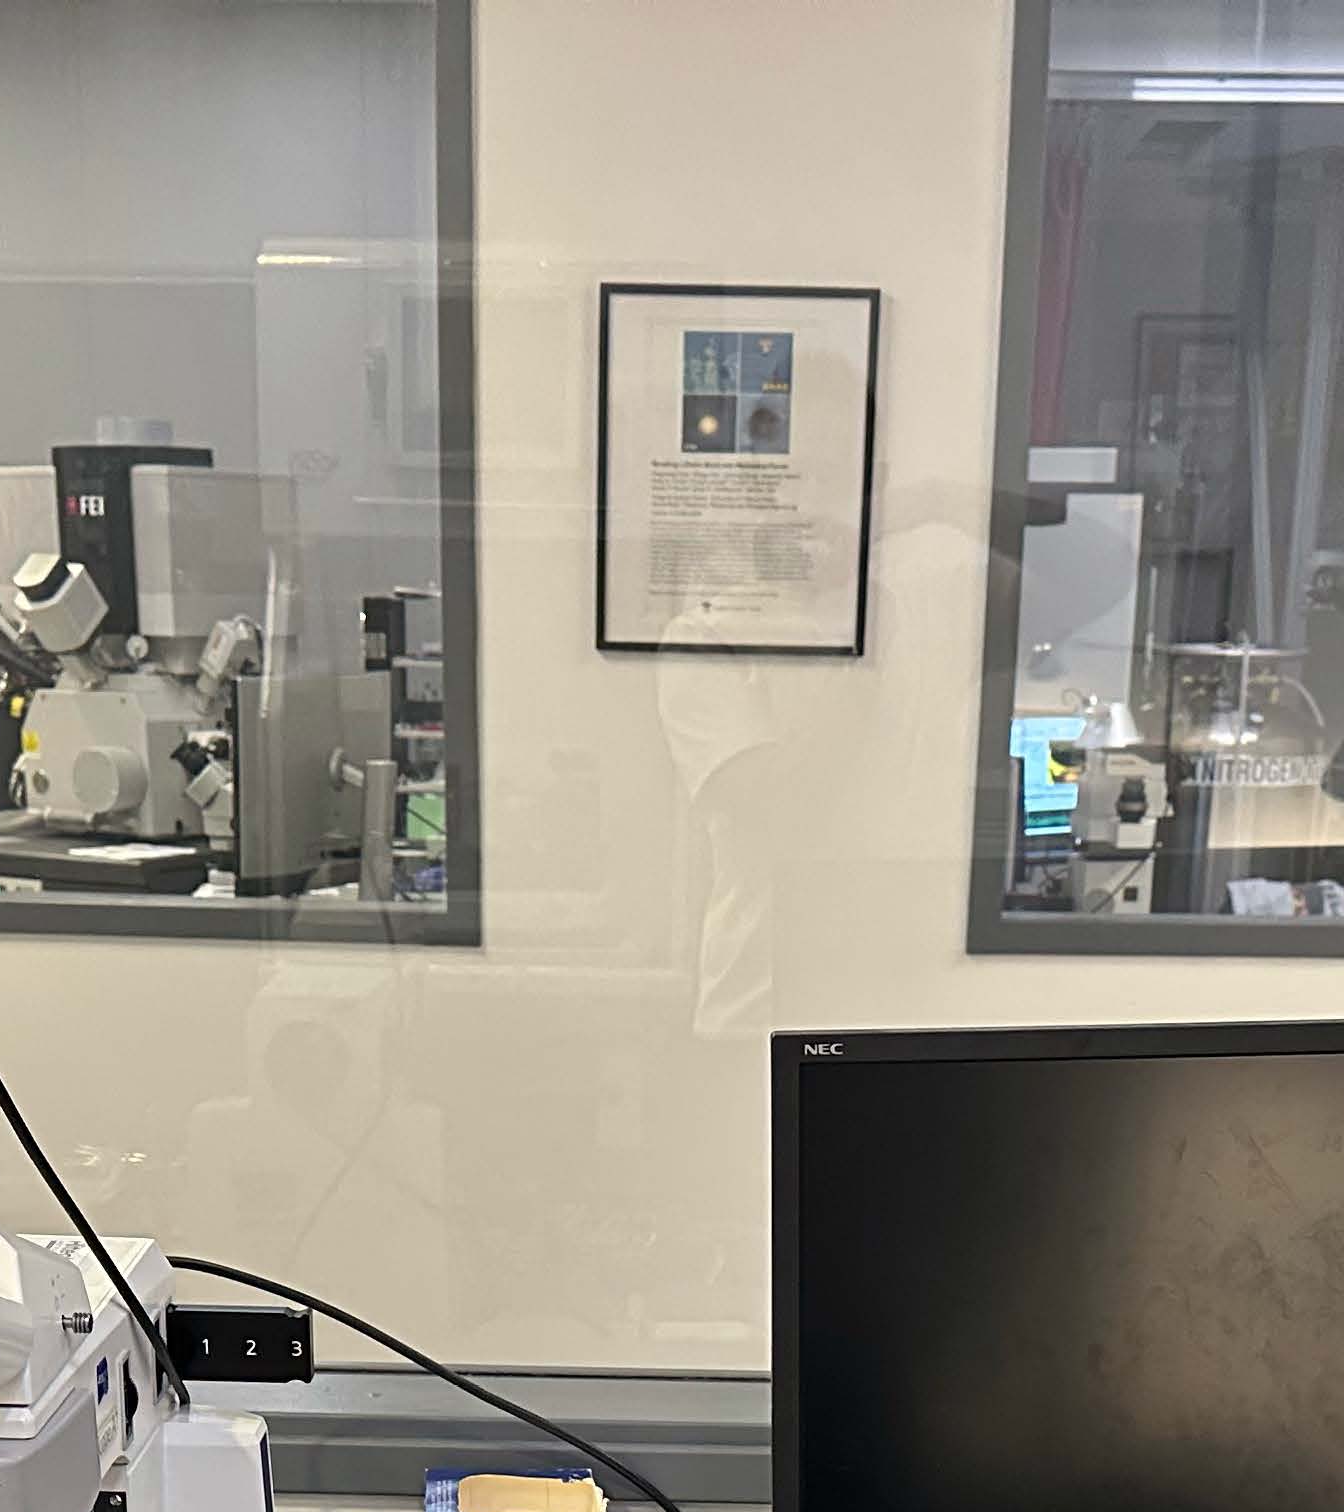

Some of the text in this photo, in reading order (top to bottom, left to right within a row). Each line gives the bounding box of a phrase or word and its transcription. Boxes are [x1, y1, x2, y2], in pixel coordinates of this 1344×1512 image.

[79, 494, 105, 516] FEI
[803, 1043, 844, 1056] NEC
[201, 1338, 303, 1357] 1 2 3
